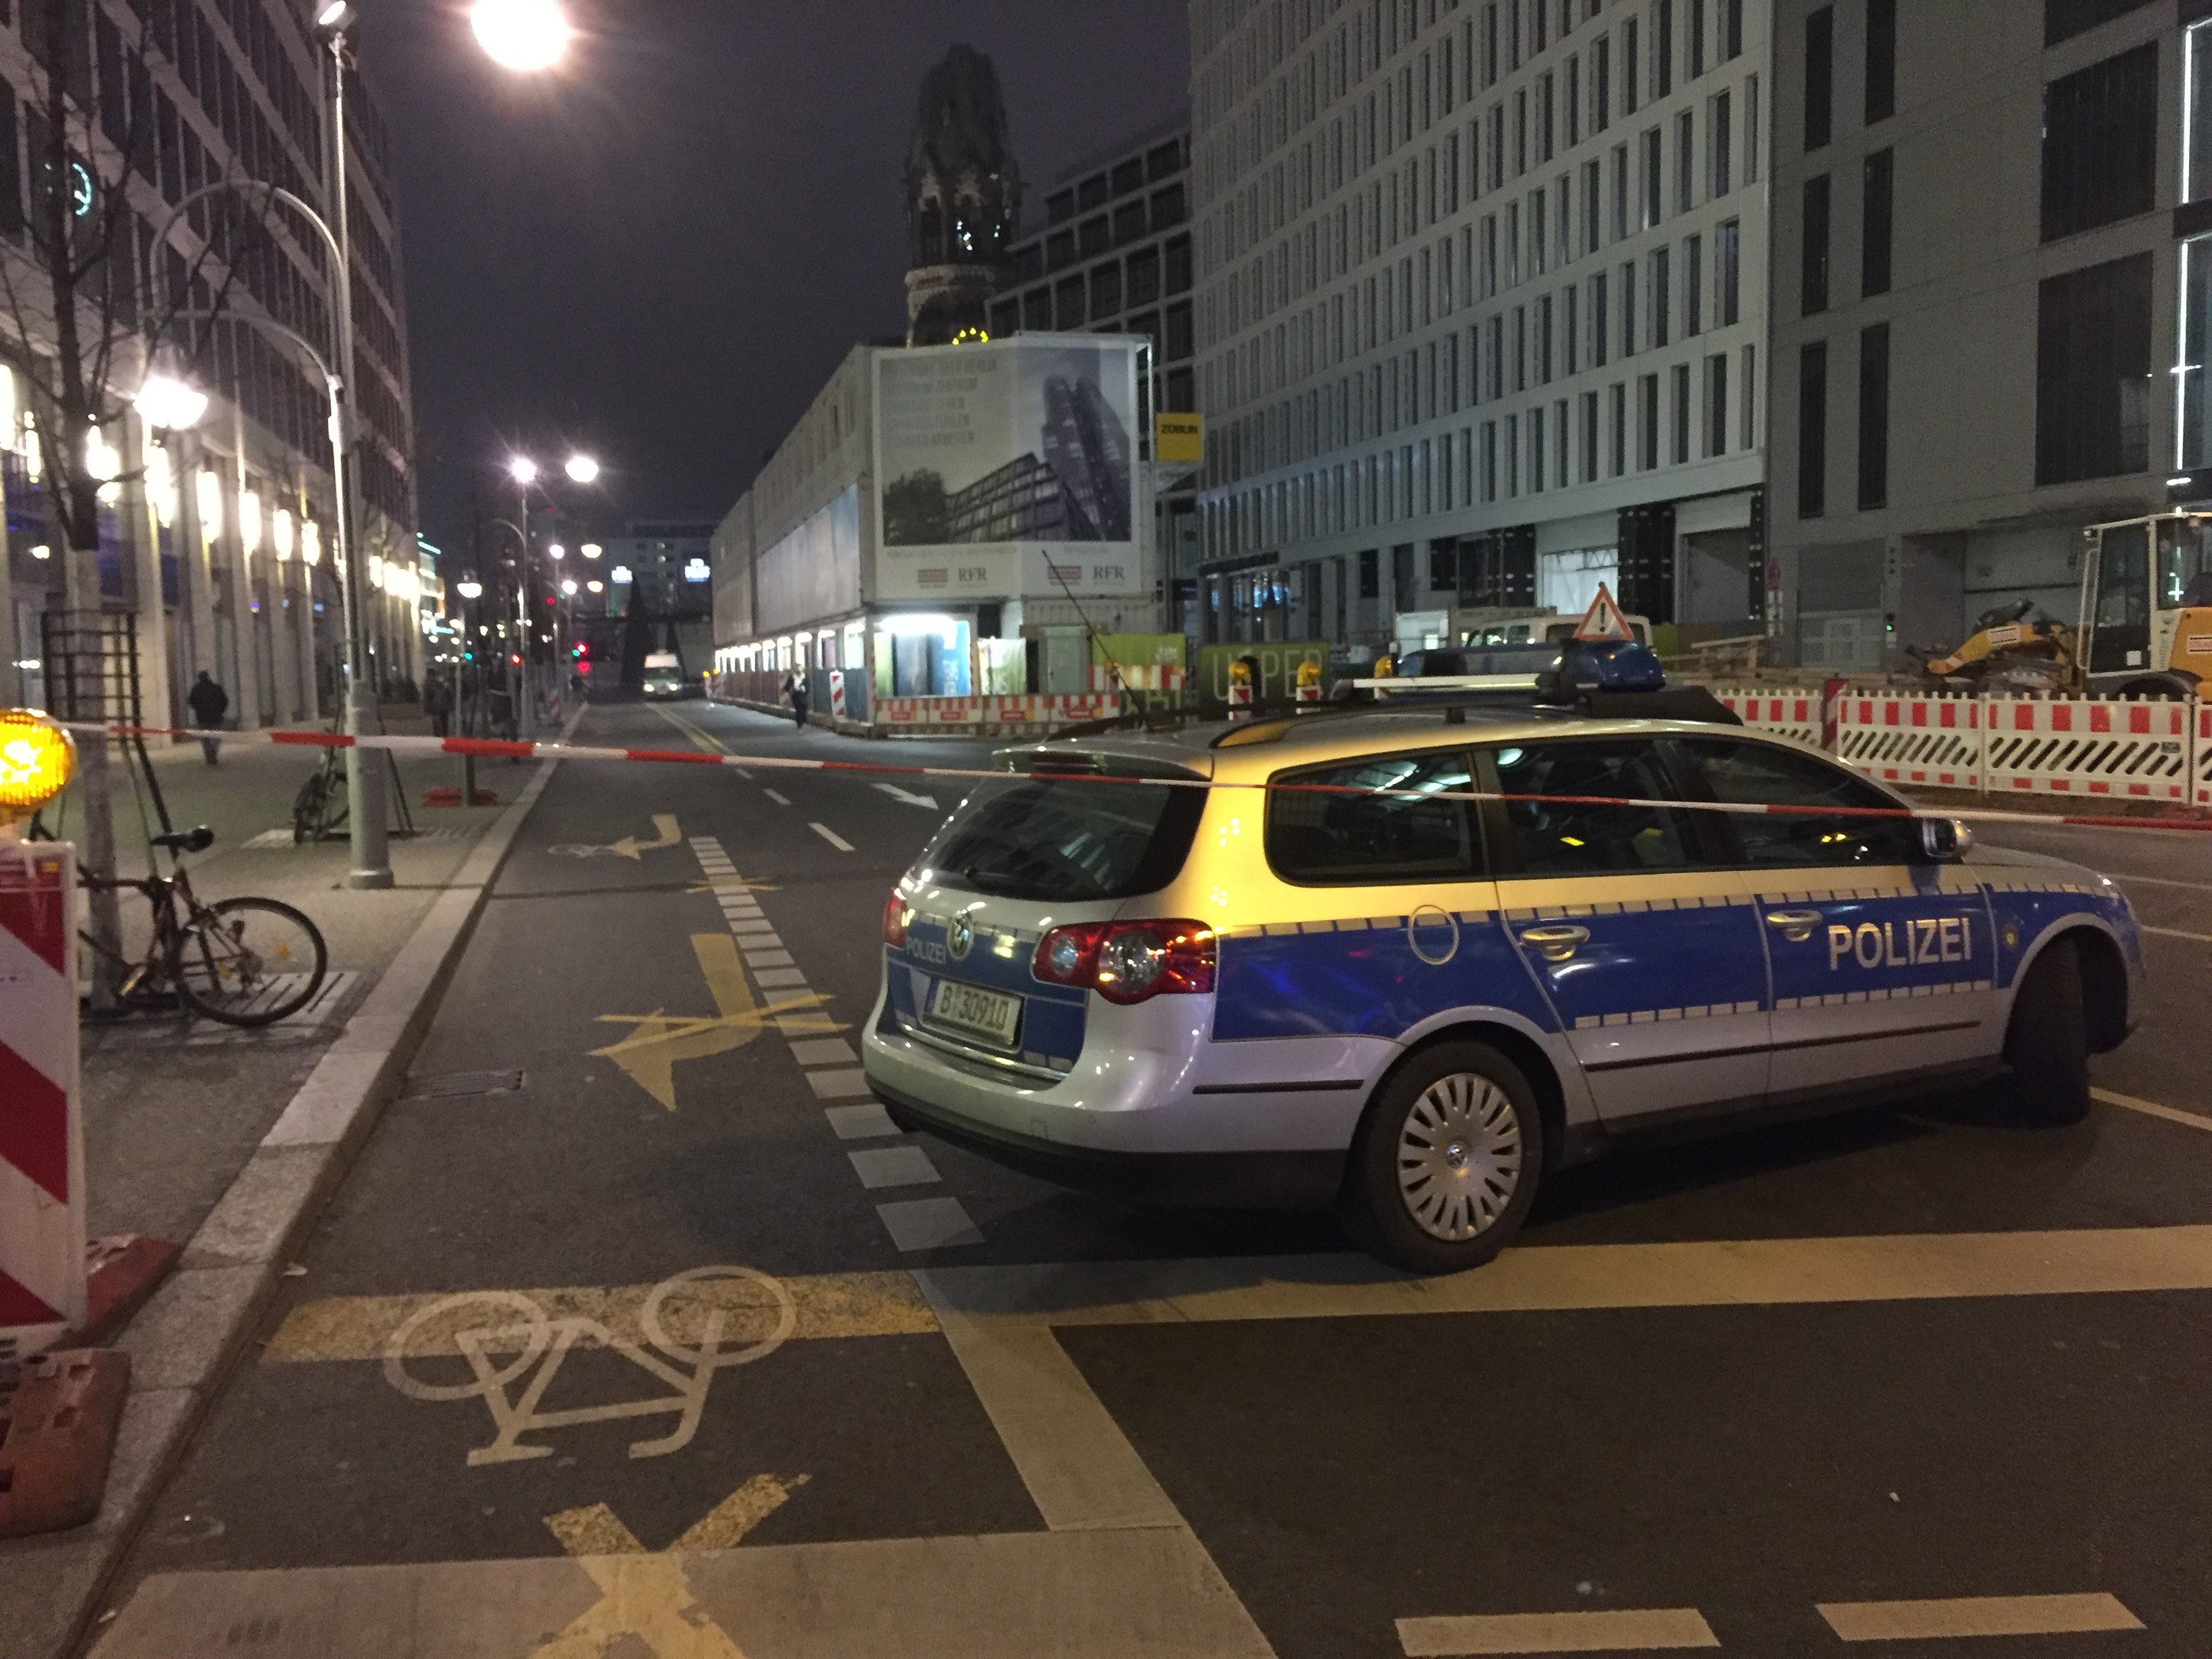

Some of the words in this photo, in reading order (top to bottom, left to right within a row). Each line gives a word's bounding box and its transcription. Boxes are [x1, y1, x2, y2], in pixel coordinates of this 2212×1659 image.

[959, 567, 987, 581] RFR
[1093, 565, 1124, 579] RFR
[1213, 649, 1323, 700] UPER
[907, 937, 946, 964] POLIZEI
[1828, 917, 1972, 971] POLIZEI
